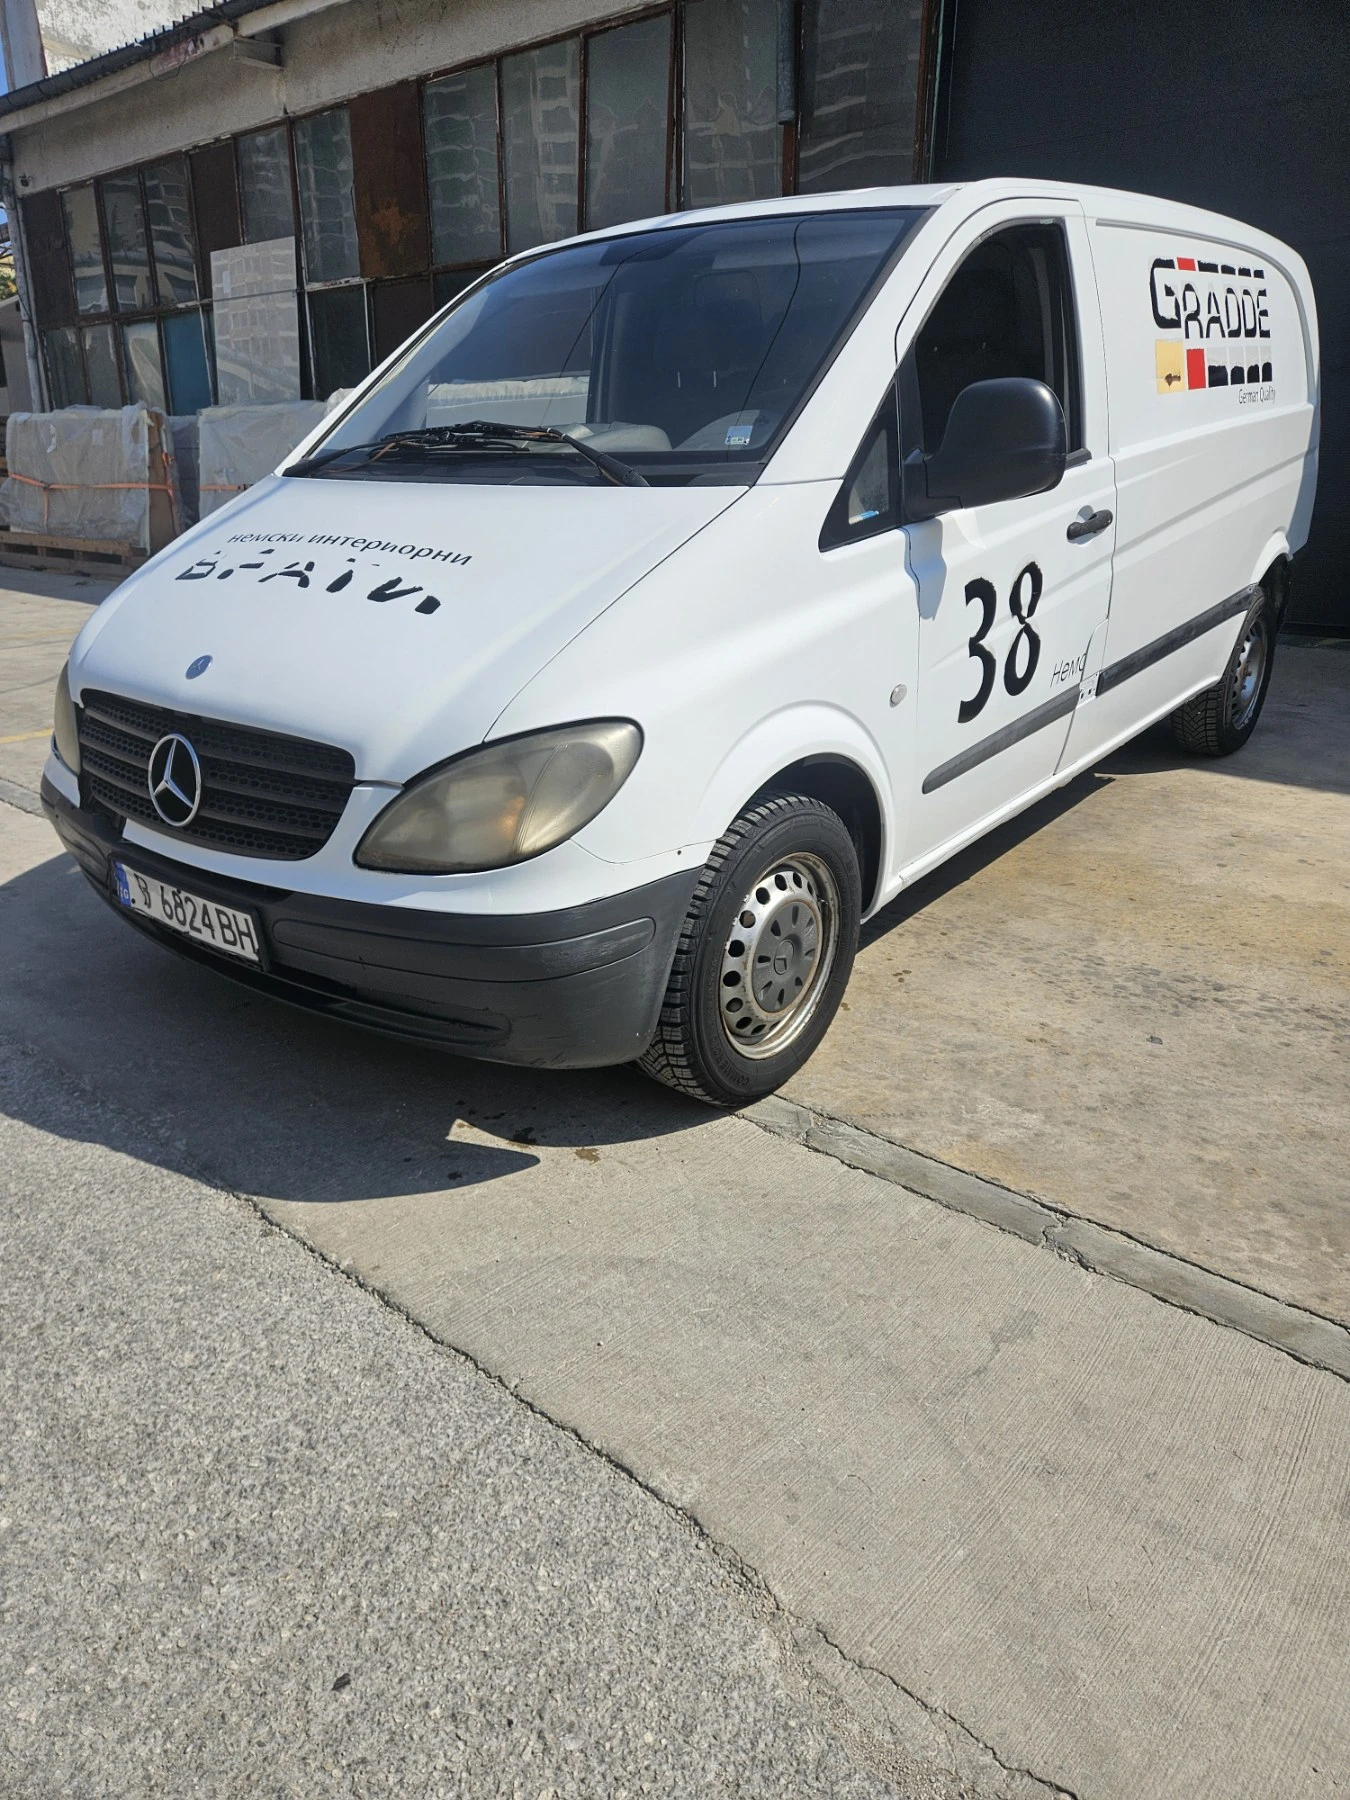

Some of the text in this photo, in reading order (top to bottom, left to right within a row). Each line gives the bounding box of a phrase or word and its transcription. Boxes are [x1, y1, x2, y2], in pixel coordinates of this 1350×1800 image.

[1150, 258, 1271, 339] GRADDE
[1239, 386, 1276, 404] German Quality
[227, 533, 474, 566] немски интериорни
[957, 560, 1044, 724] 38
